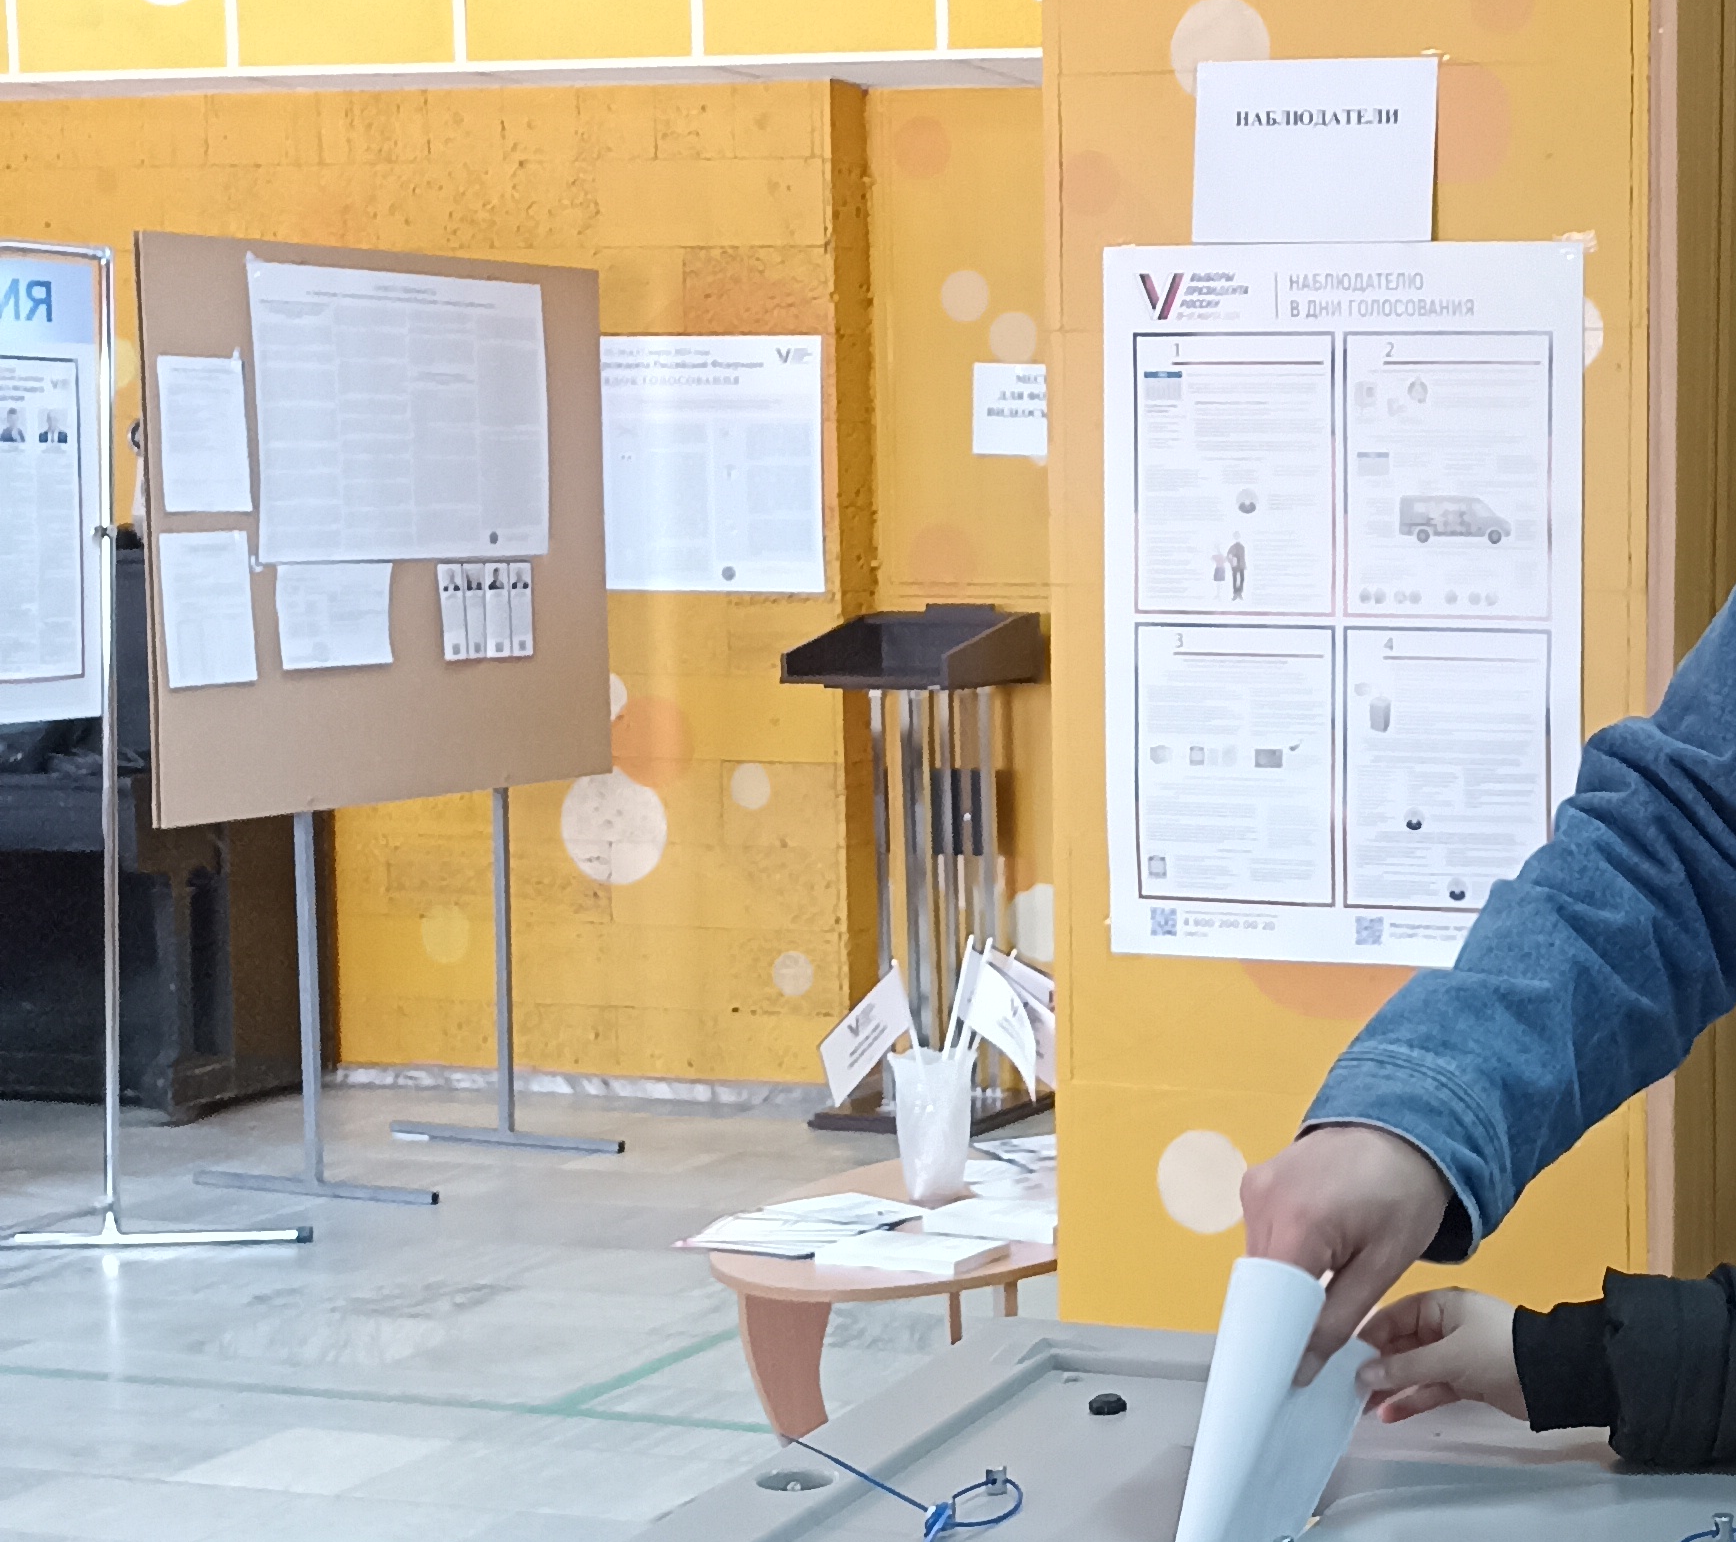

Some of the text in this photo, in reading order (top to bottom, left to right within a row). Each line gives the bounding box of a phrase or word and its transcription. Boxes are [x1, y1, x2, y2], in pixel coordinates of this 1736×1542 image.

[1236, 109, 1399, 127] НАБЛЮДАТЕЛИ
[1289, 273, 1424, 292] НАБЛЮДАТЕЛЮ
[1290, 298, 1475, 319] В ДНИ ГОЛОСОВАНИЯ
[1173, 343, 1180, 357] 1
[1385, 341, 1395, 358] 2
[1175, 632, 1184, 649] 3
